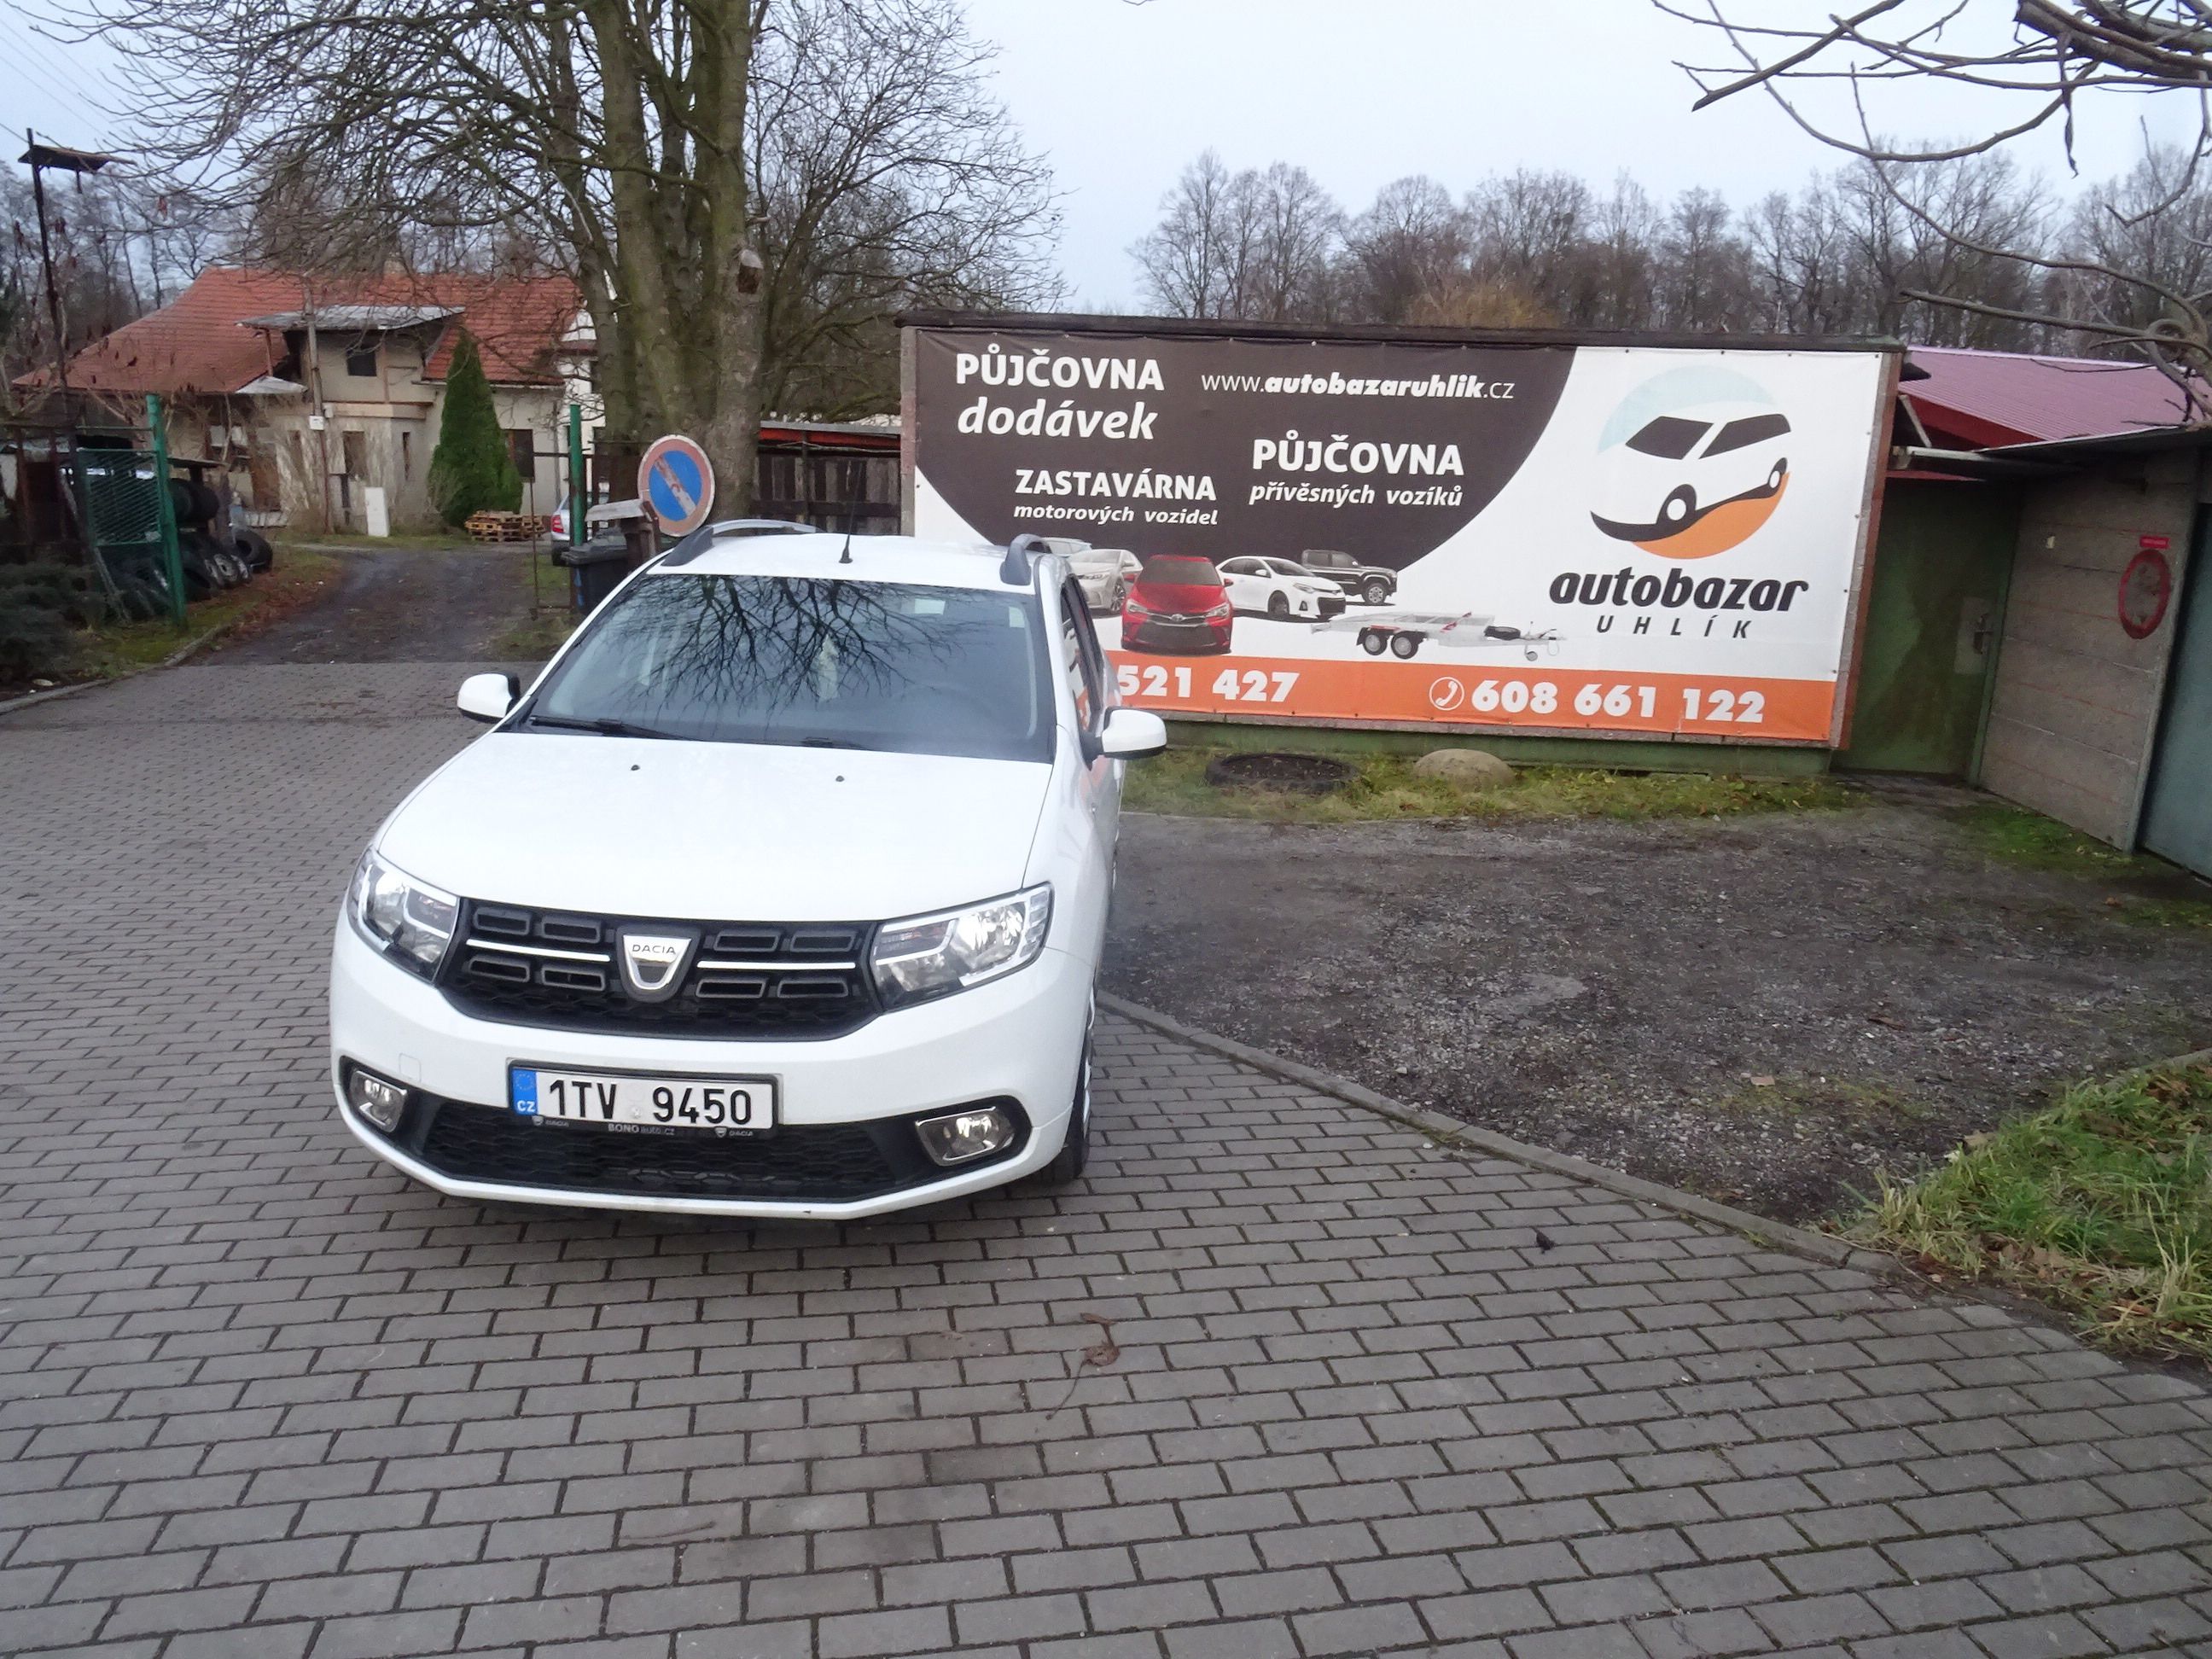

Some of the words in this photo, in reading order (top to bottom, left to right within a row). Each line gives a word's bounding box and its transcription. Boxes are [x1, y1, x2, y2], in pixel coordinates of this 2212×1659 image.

[956, 344, 1164, 390] PŮJČOVNA
[1202, 371, 1515, 400] www.autobazaruhlik.cz
[957, 397, 1158, 439] dodávek
[1252, 429, 1464, 476] PŮJČOVNA
[1015, 469, 1216, 501] ZASTAVÁRNA
[1249, 480, 1375, 505] přívěsných
[1386, 483, 1463, 506] vozíků
[1013, 503, 1135, 524] motorových
[1144, 508, 1218, 526] vozidel
[1549, 567, 1809, 611] autobazar
[1118, 665, 1192, 698] 521
[1212, 669, 1300, 701] 427
[1471, 680, 1557, 713] 608
[1574, 684, 1656, 718] 661
[1683, 688, 1765, 723] 122
[632, 944, 676, 955] DACIA
[516, 1099, 536, 1113] CZ
[550, 1080, 617, 1120] 1TV
[652, 1086, 751, 1125] 9450
